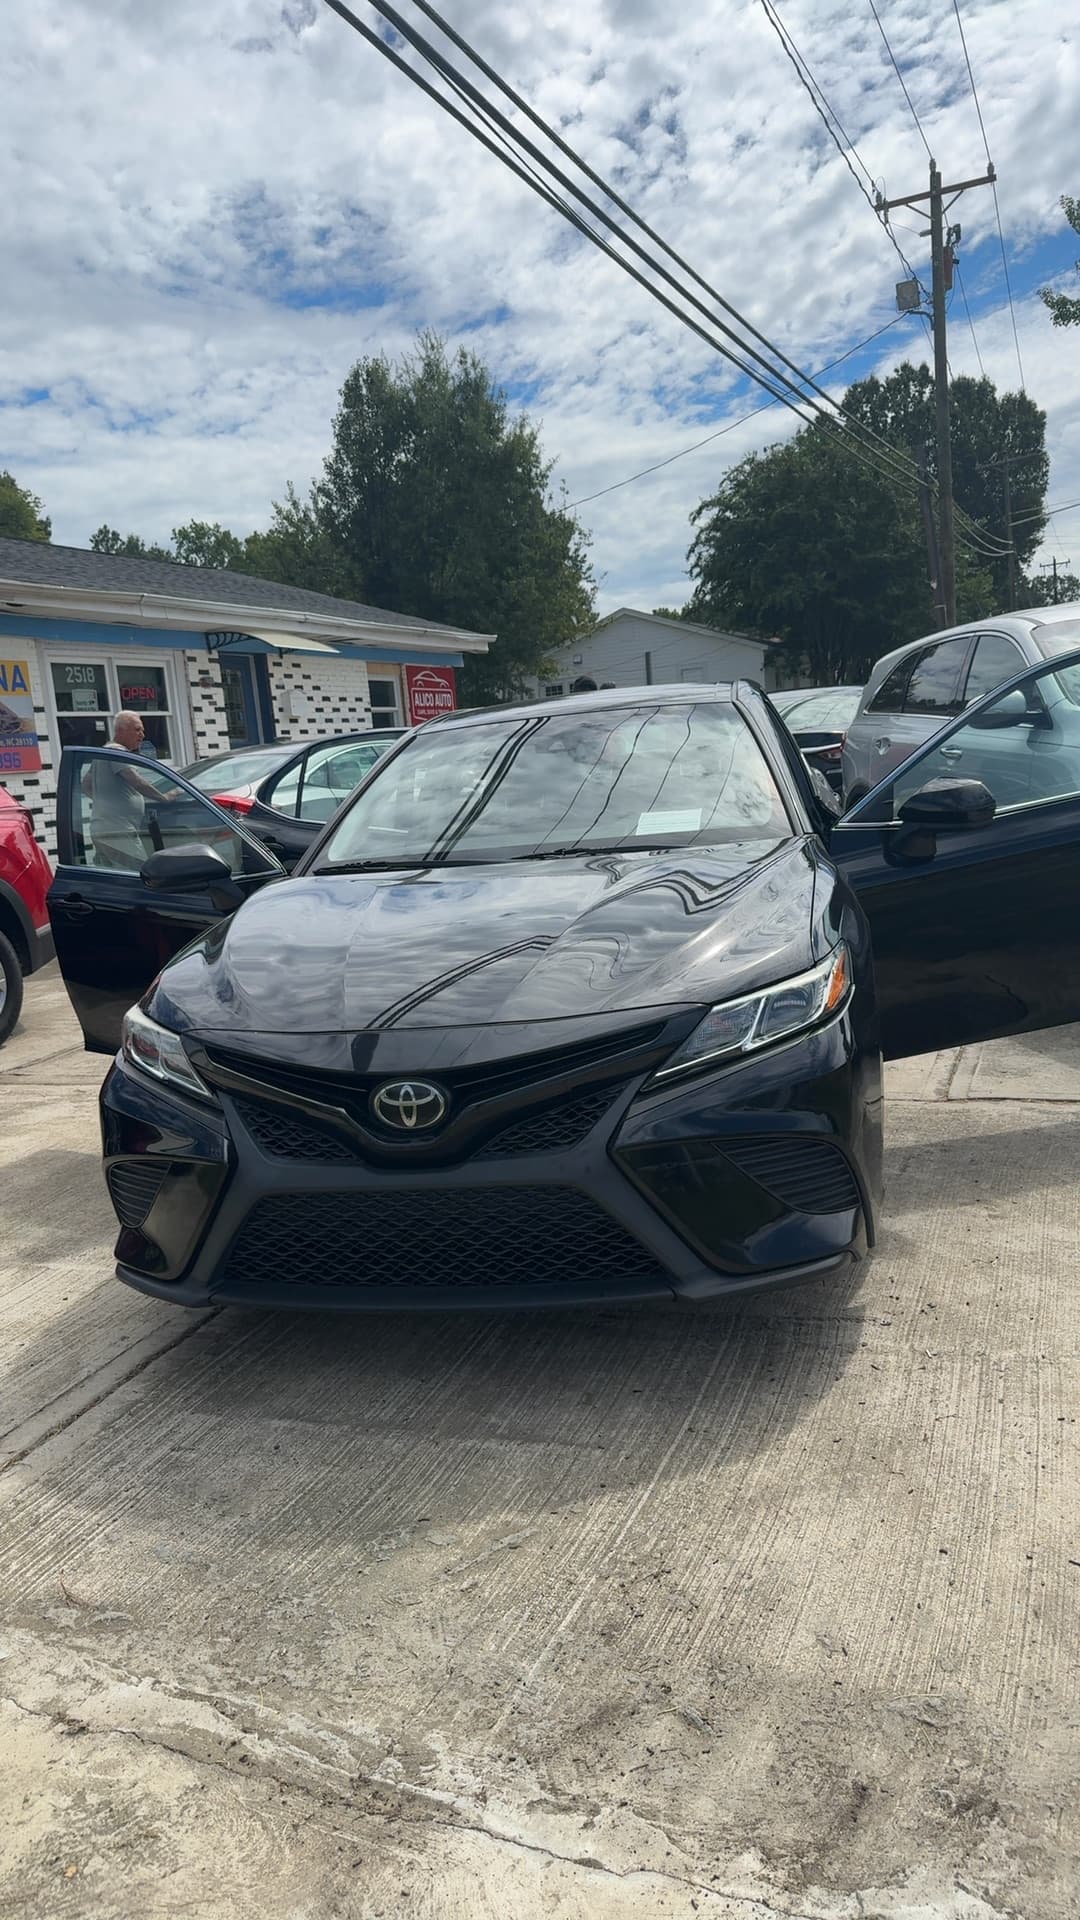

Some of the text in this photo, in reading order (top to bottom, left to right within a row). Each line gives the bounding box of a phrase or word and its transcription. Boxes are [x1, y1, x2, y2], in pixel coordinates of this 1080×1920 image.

[65, 667, 95, 683] 2518
[122, 687, 155, 700] OPEN
[415, 692, 451, 707] ALICO AUTO
